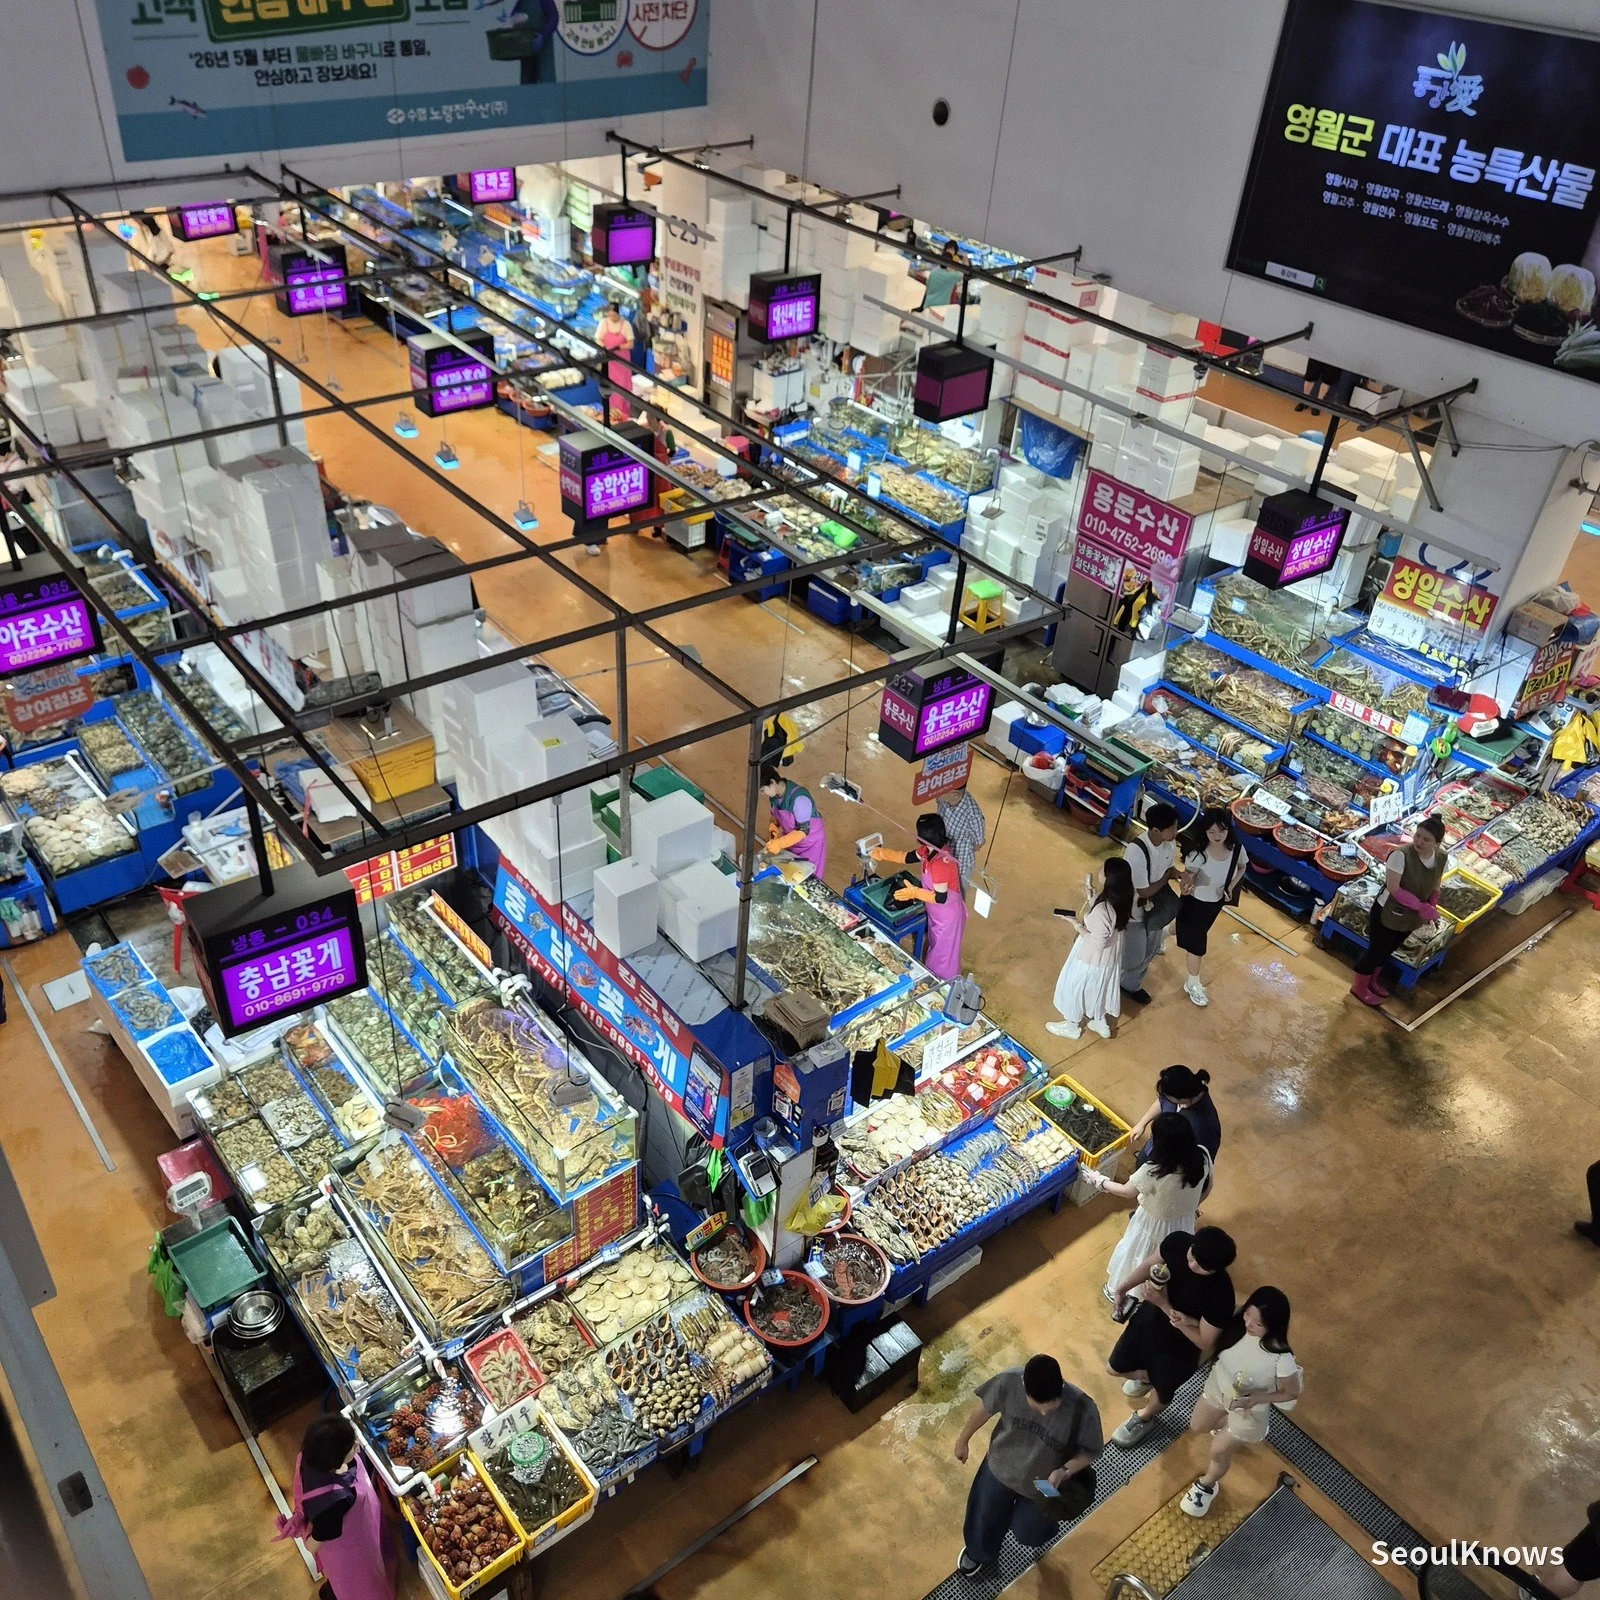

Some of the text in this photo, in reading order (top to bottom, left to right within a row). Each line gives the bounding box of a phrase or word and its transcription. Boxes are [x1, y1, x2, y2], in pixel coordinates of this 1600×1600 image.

[254, 63, 377, 87] 안심하고 장보세요!
[1284, 103, 1596, 210] 영월군 대표 농특산물
[1325, 172, 1358, 191] 영월사과
[590, 466, 644, 502] 송학상회
[1093, 482, 1179, 547] 용문수산
[1253, 535, 1284, 562] 성일수산
[1291, 529, 1336, 560] 성일수산
[1392, 565, 1491, 631] 성일수산
[0, 605, 83, 651] 아주수산
[883, 698, 914, 732] 용문수산
[924, 688, 985, 734] 용문수산
[917, 762, 968, 796] 참여점포
[231, 929, 266, 951] 냉동
[295, 907, 334, 930] 034
[563, 904, 598, 952] 대게
[238, 937, 344, 1000] 충남꽃게
[244, 973, 345, 1017] 010-8691-9779
